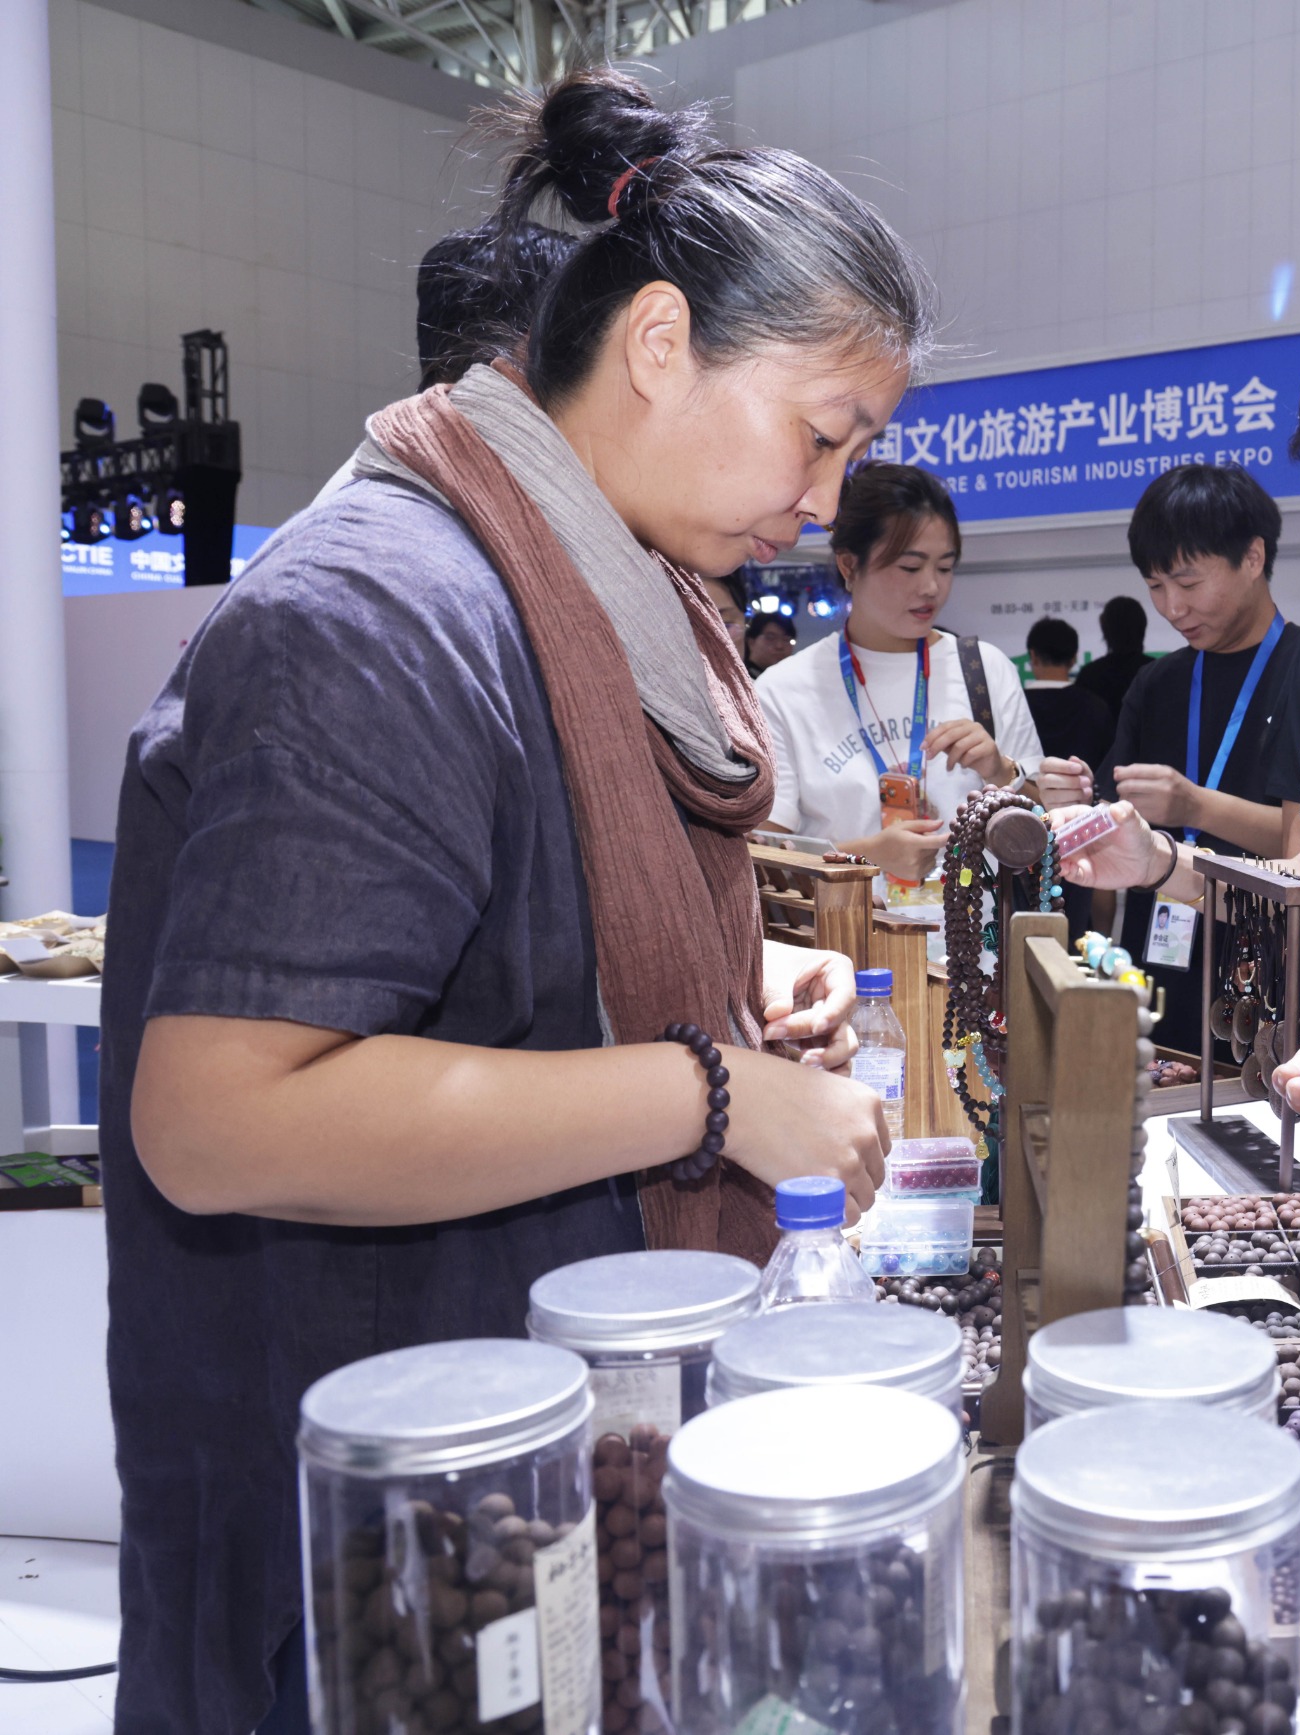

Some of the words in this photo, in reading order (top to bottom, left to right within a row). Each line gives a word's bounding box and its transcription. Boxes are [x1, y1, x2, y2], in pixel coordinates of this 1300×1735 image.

[864, 376, 1278, 465] 国文化旅游产业博览会
[994, 464, 1078, 490] TOURISM
[1085, 453, 1205, 480] INDUSTRIES
[1215, 446, 1273, 468] EXPO
[60, 543, 114, 566] CTIE
[823, 733, 862, 774] BLUE
